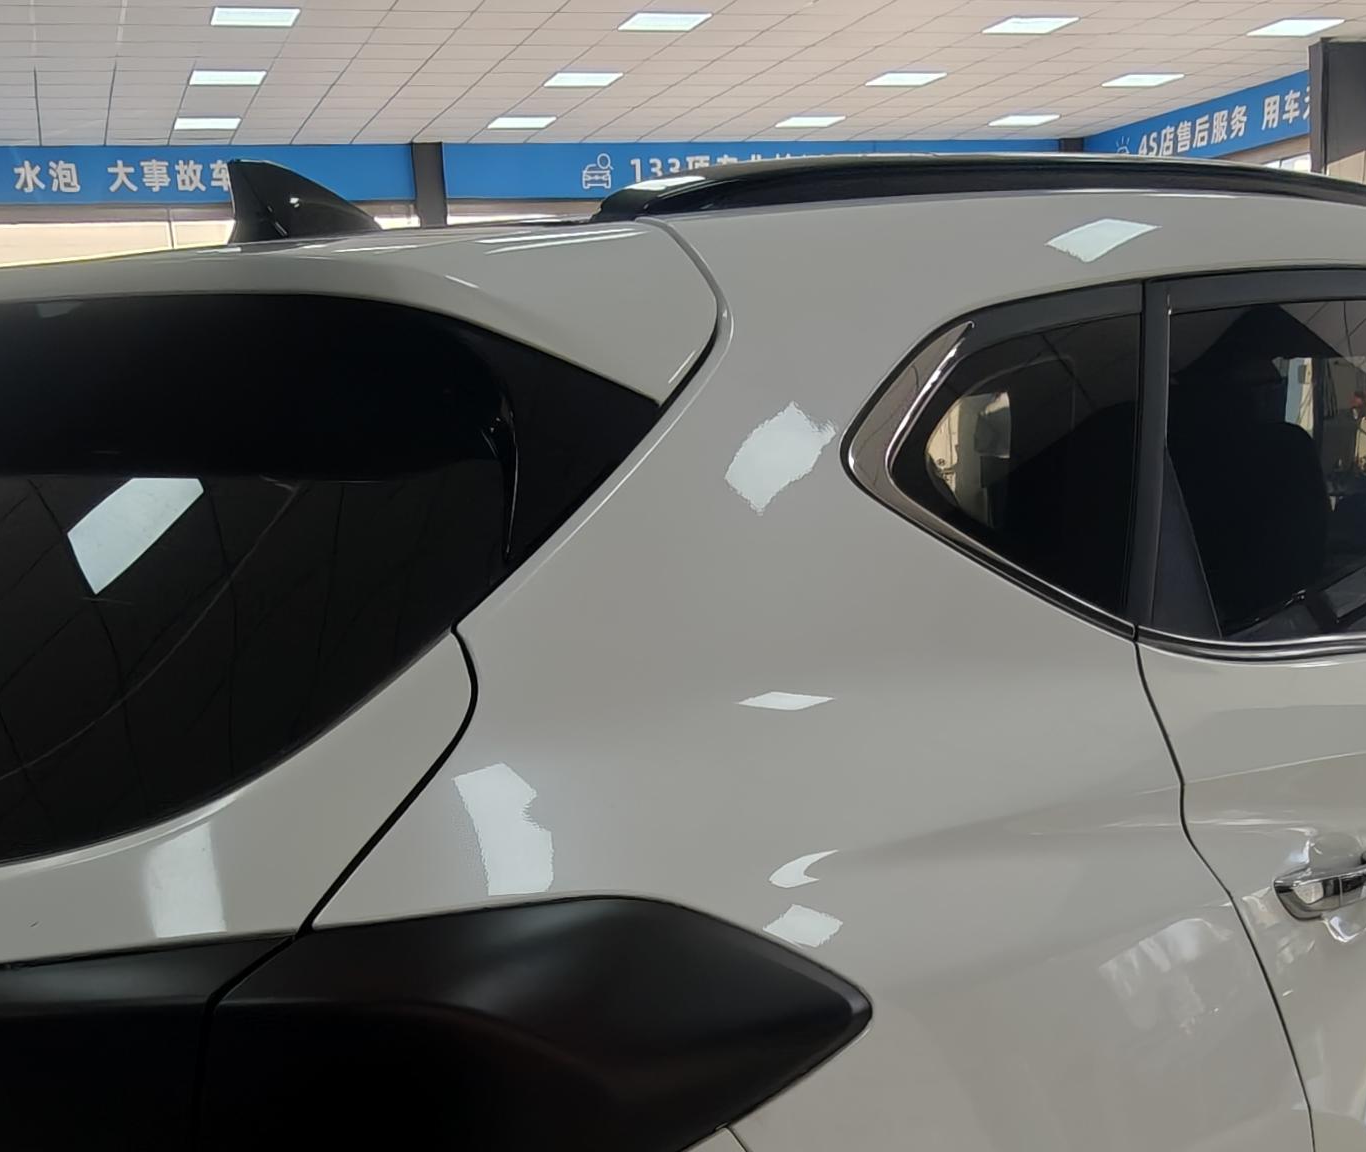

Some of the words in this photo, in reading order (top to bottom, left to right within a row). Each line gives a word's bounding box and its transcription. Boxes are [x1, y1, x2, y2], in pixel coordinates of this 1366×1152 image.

[1138, 106, 1248, 157] 4S店售后服务
[1262, 86, 1310, 131] 用车
[13, 160, 81, 193] 水泡
